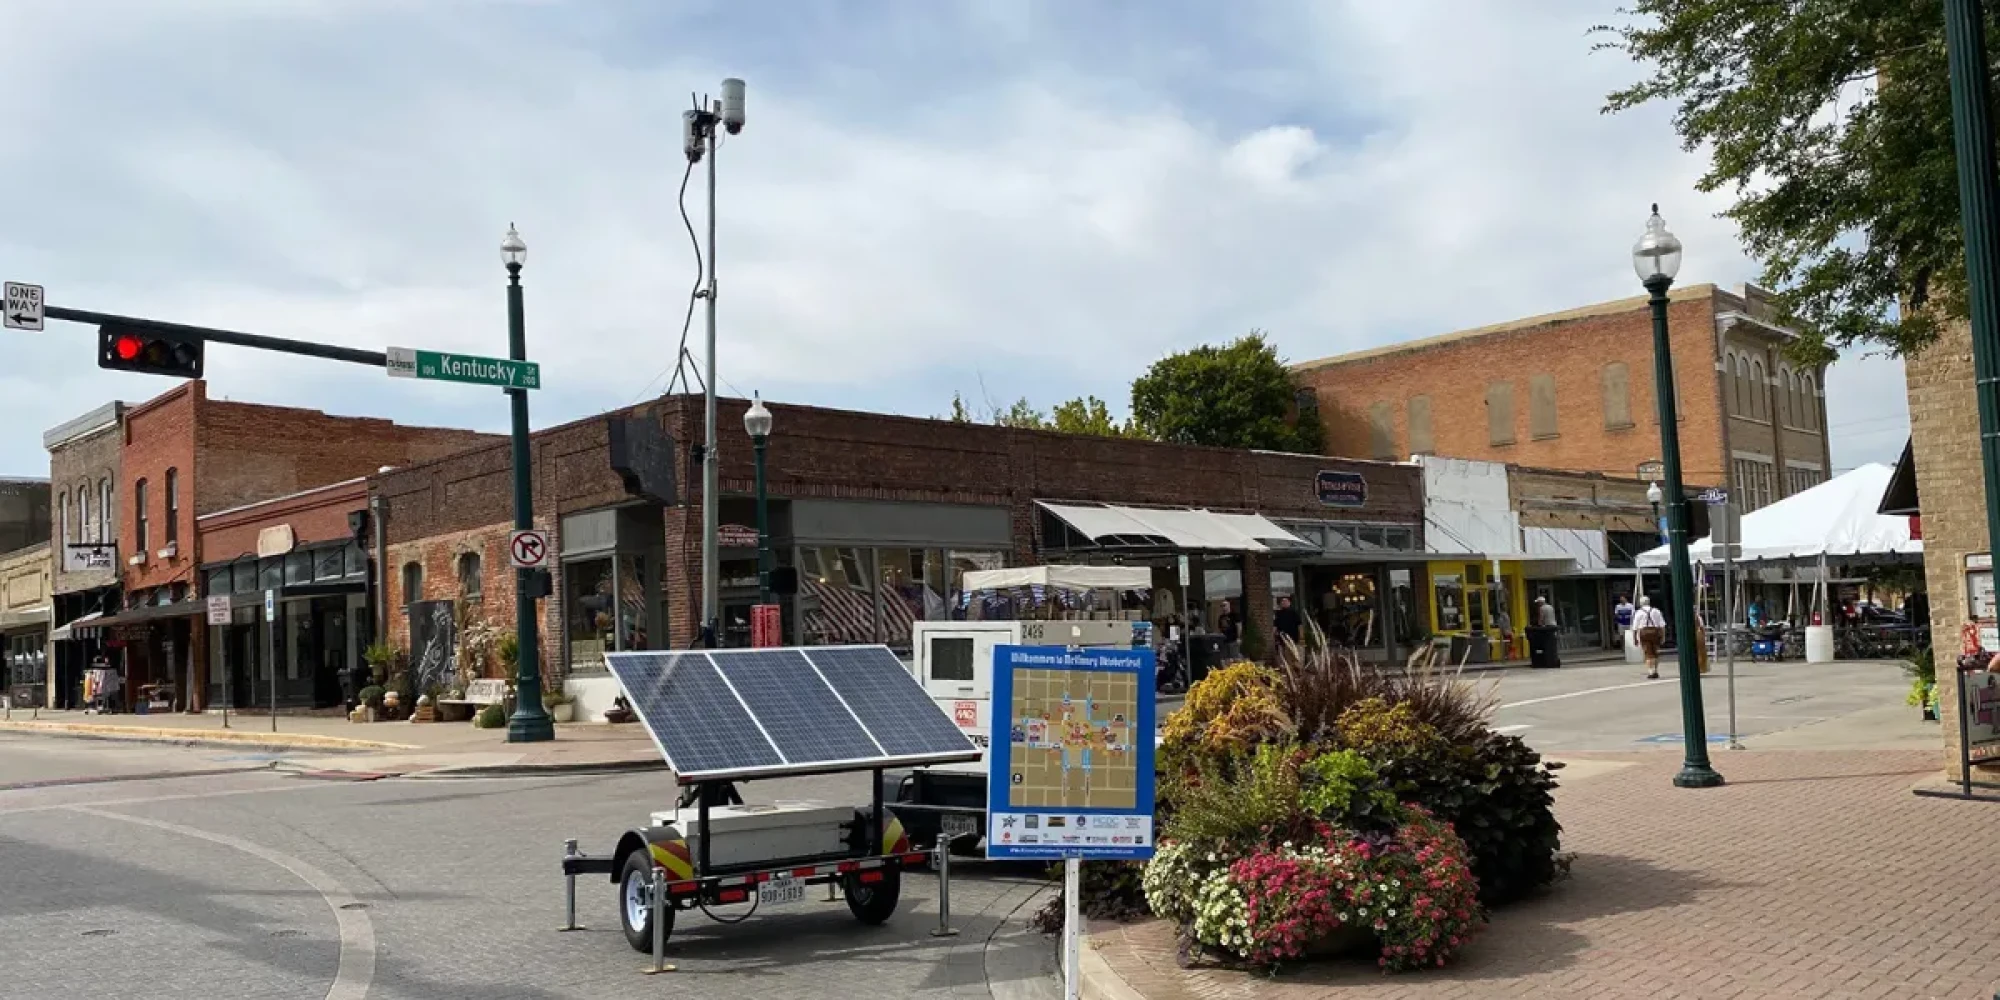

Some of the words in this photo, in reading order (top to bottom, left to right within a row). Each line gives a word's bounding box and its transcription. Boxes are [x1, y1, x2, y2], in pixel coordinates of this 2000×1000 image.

[9, 286, 39, 300] ONE
[8, 299, 39, 312] WAY
[440, 354, 517, 386] Kentucky
